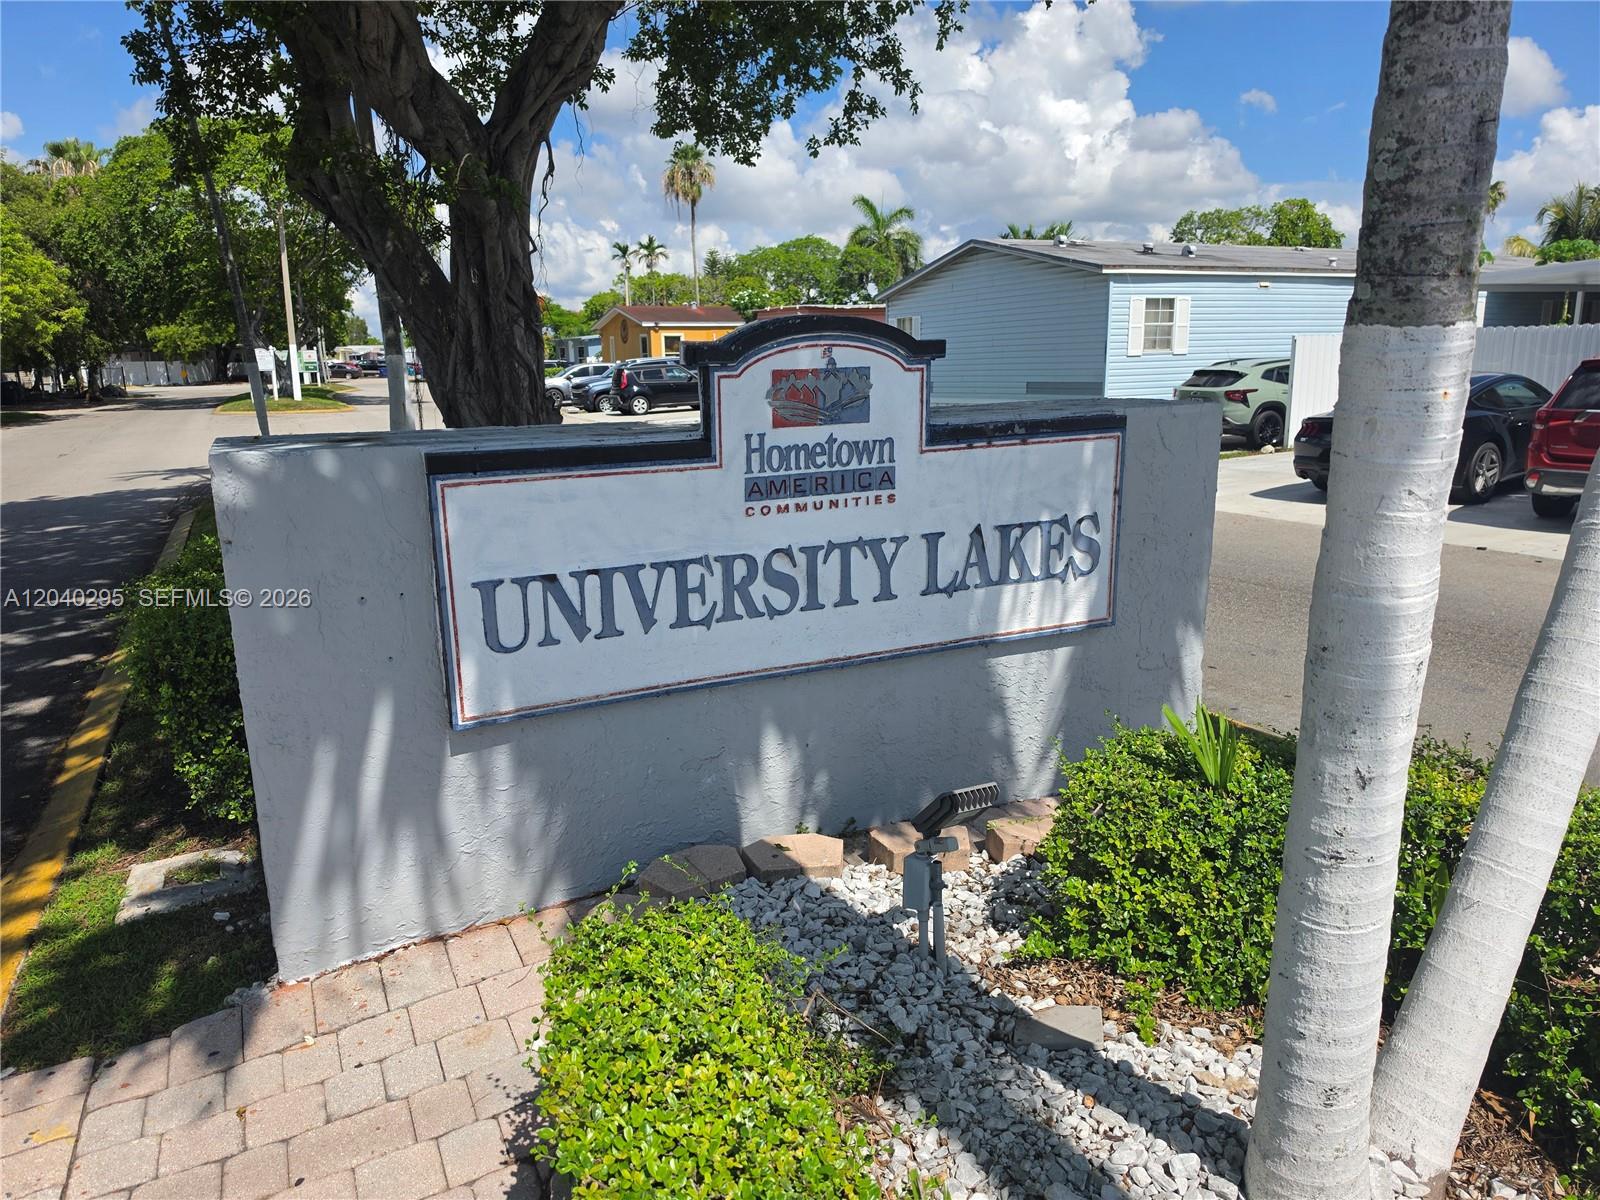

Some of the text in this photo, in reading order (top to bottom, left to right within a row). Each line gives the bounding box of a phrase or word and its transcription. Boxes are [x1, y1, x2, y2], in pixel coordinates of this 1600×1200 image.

[745, 432, 895, 474] Hometown
[748, 471, 894, 498] AMERICA
[746, 494, 896, 517] COMMUNITIES
[472, 512, 1101, 654] UNIVERSITY LAKES
